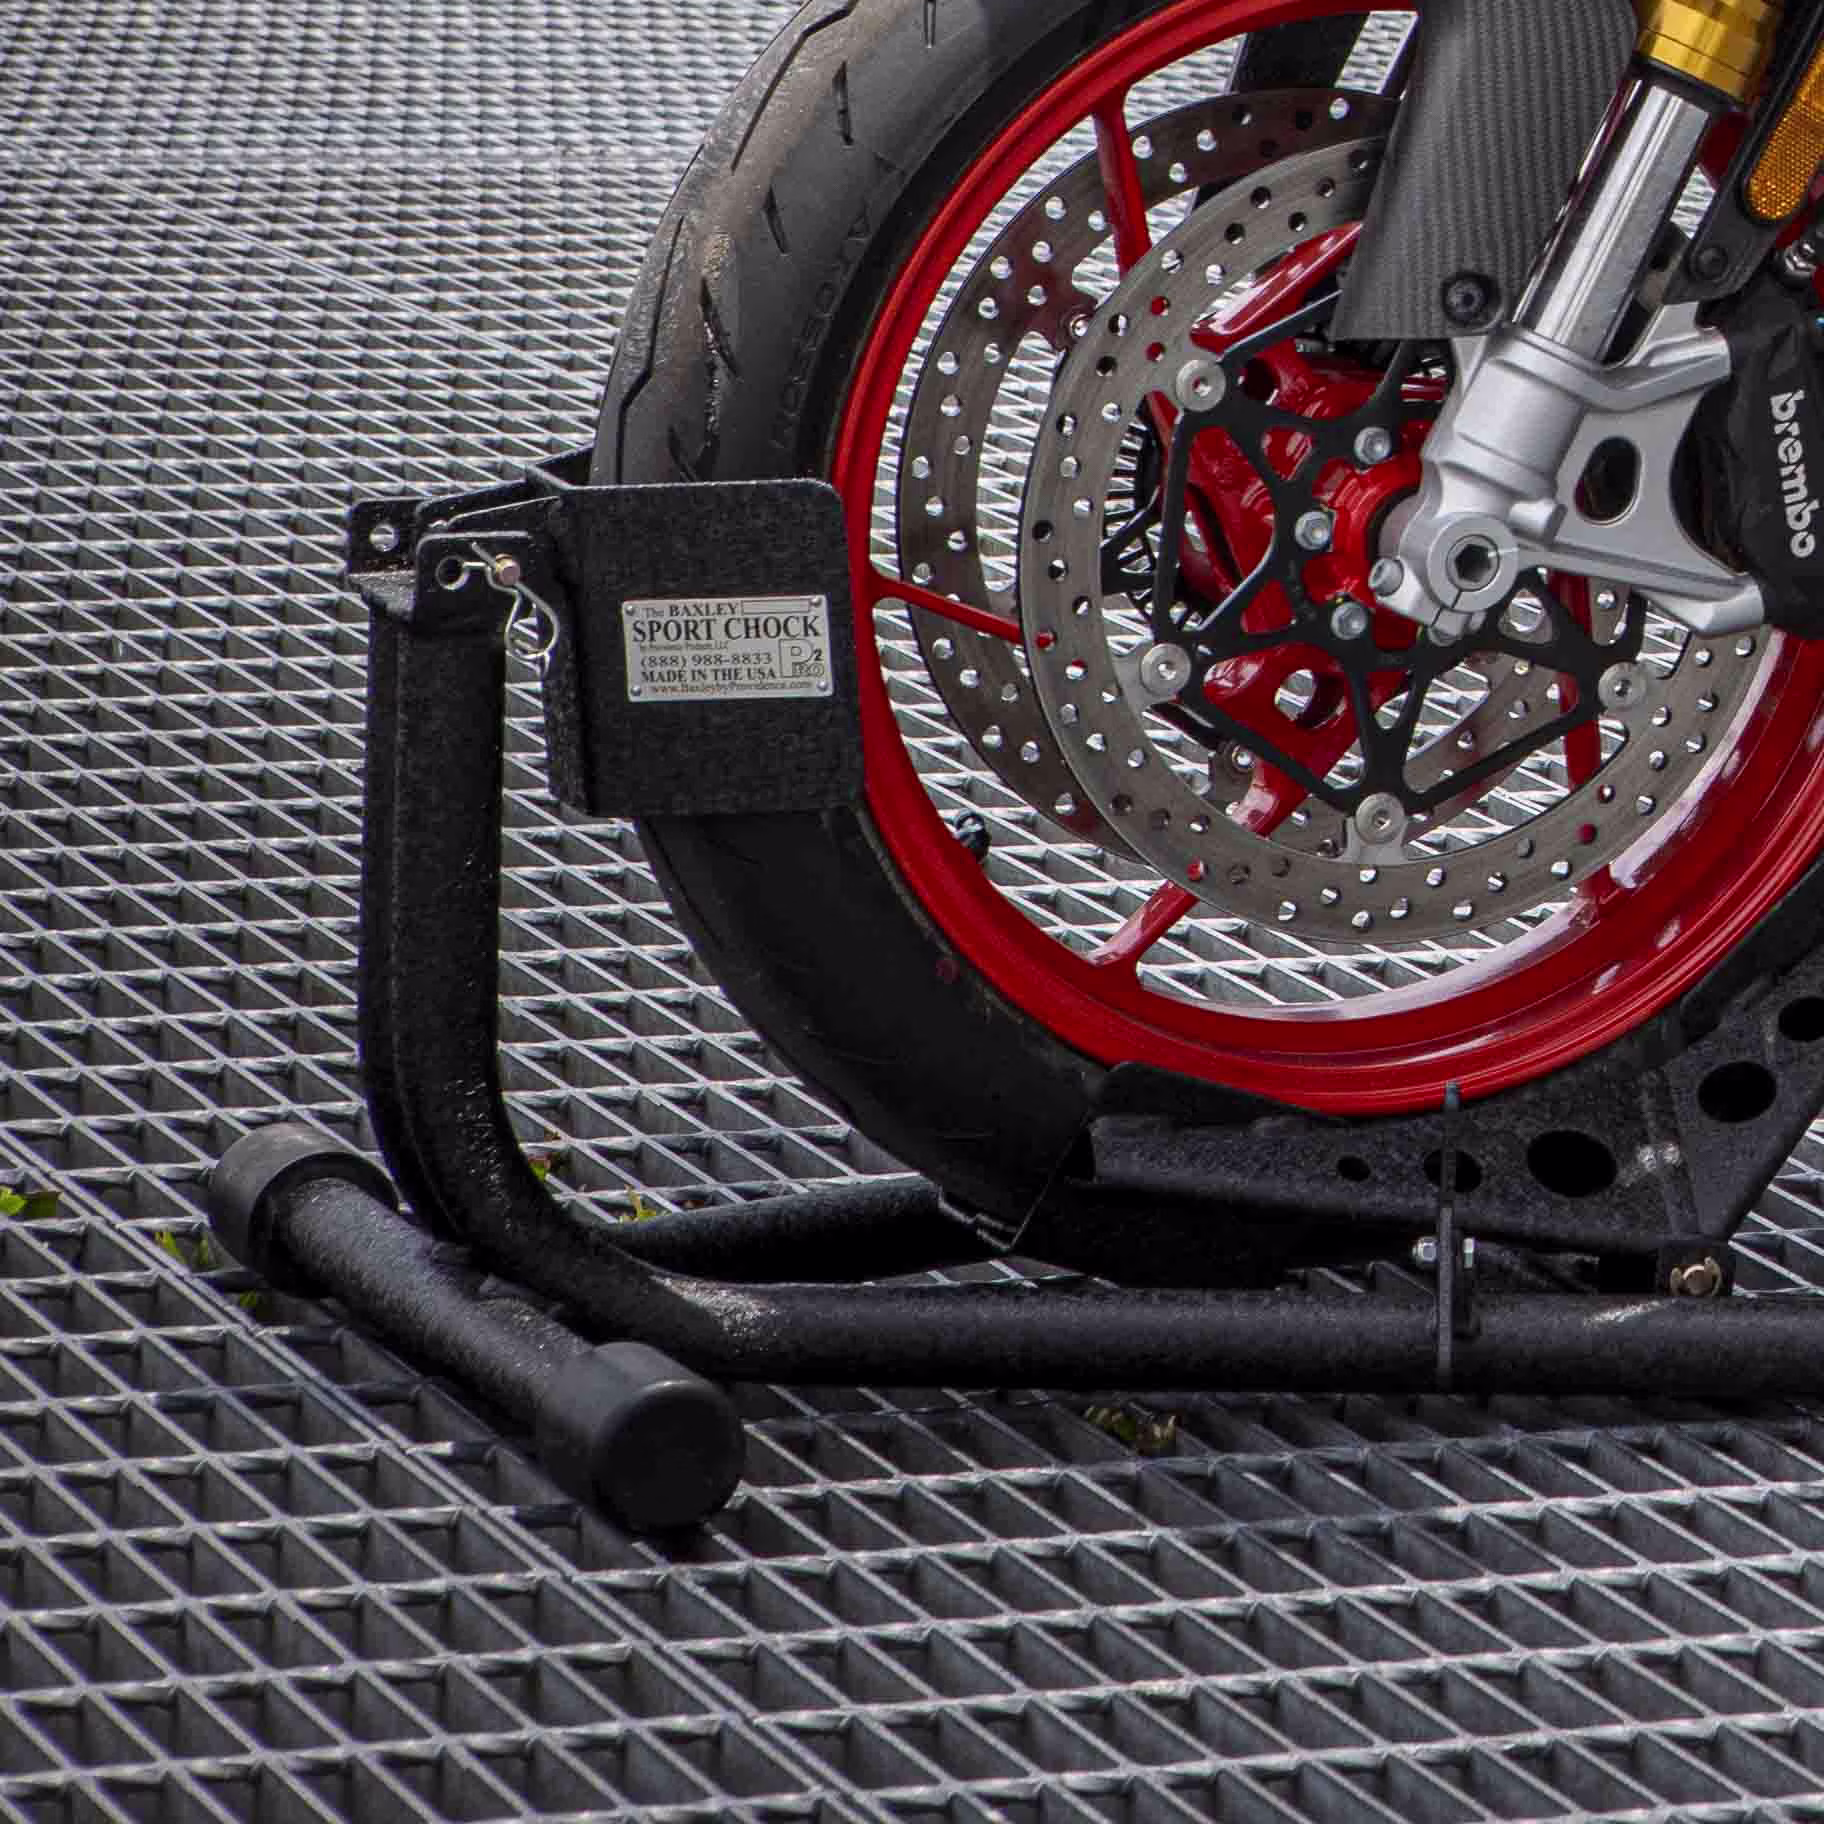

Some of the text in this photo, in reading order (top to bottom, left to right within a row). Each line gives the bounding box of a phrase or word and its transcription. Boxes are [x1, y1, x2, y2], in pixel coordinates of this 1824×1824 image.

[1770, 389, 1820, 558] brembo
[670, 602, 740, 617] BAXLEY
[632, 616, 820, 642] SPORT CHOCK
[641, 652, 773, 668] (888) 988-8833
[641, 667, 777, 683] MADE IN THE USA
